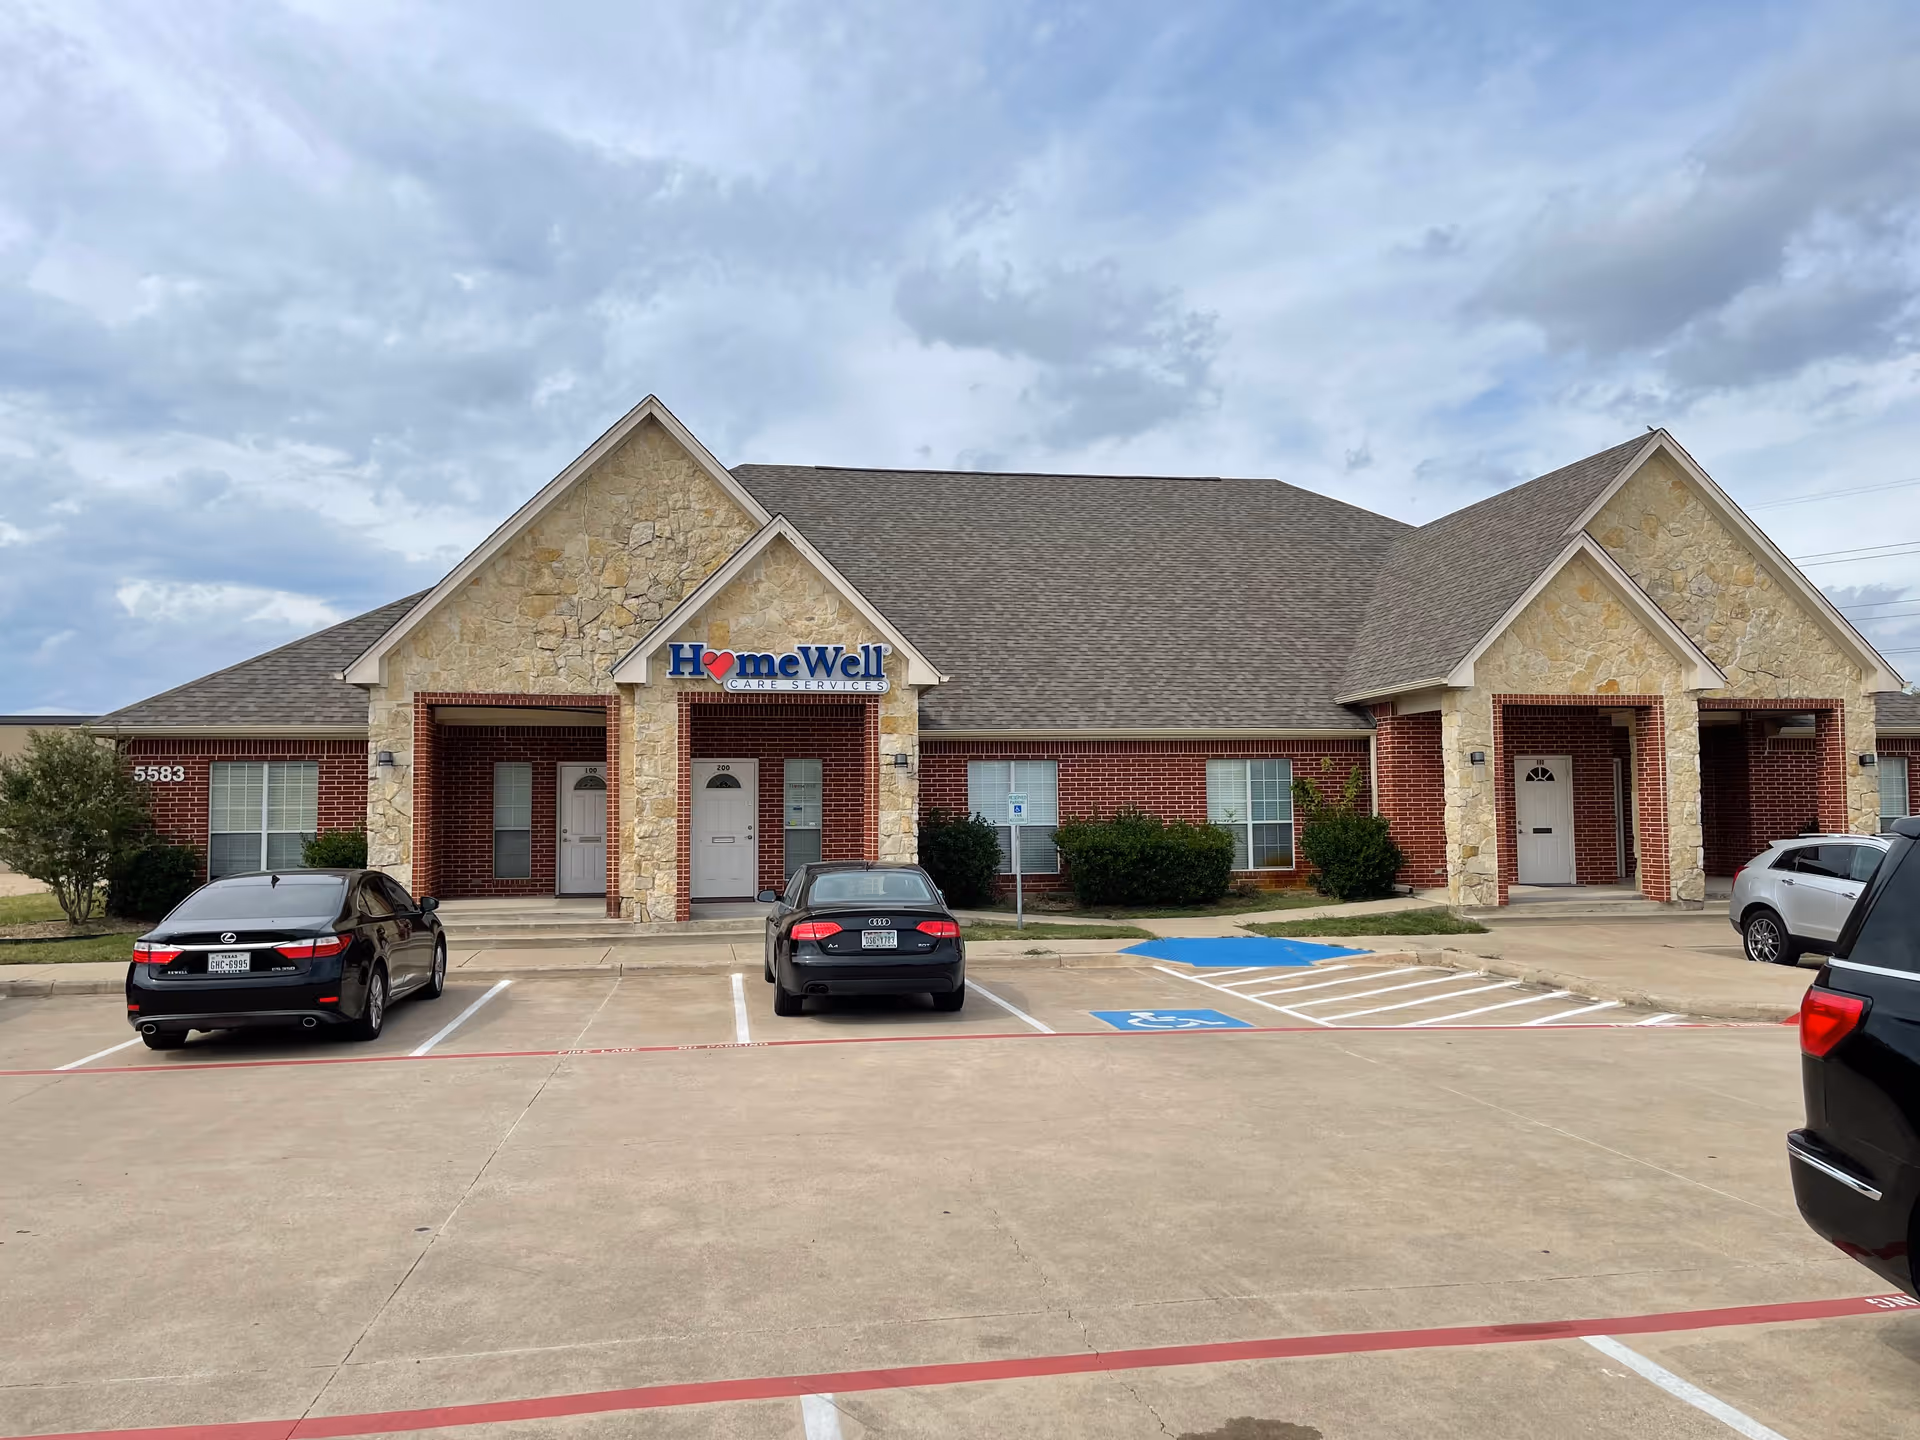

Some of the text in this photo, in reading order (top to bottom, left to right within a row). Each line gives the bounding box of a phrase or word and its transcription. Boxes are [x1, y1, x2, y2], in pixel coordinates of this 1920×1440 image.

[730, 679, 885, 691] CARE SERVICES
[133, 766, 185, 782] 5583
